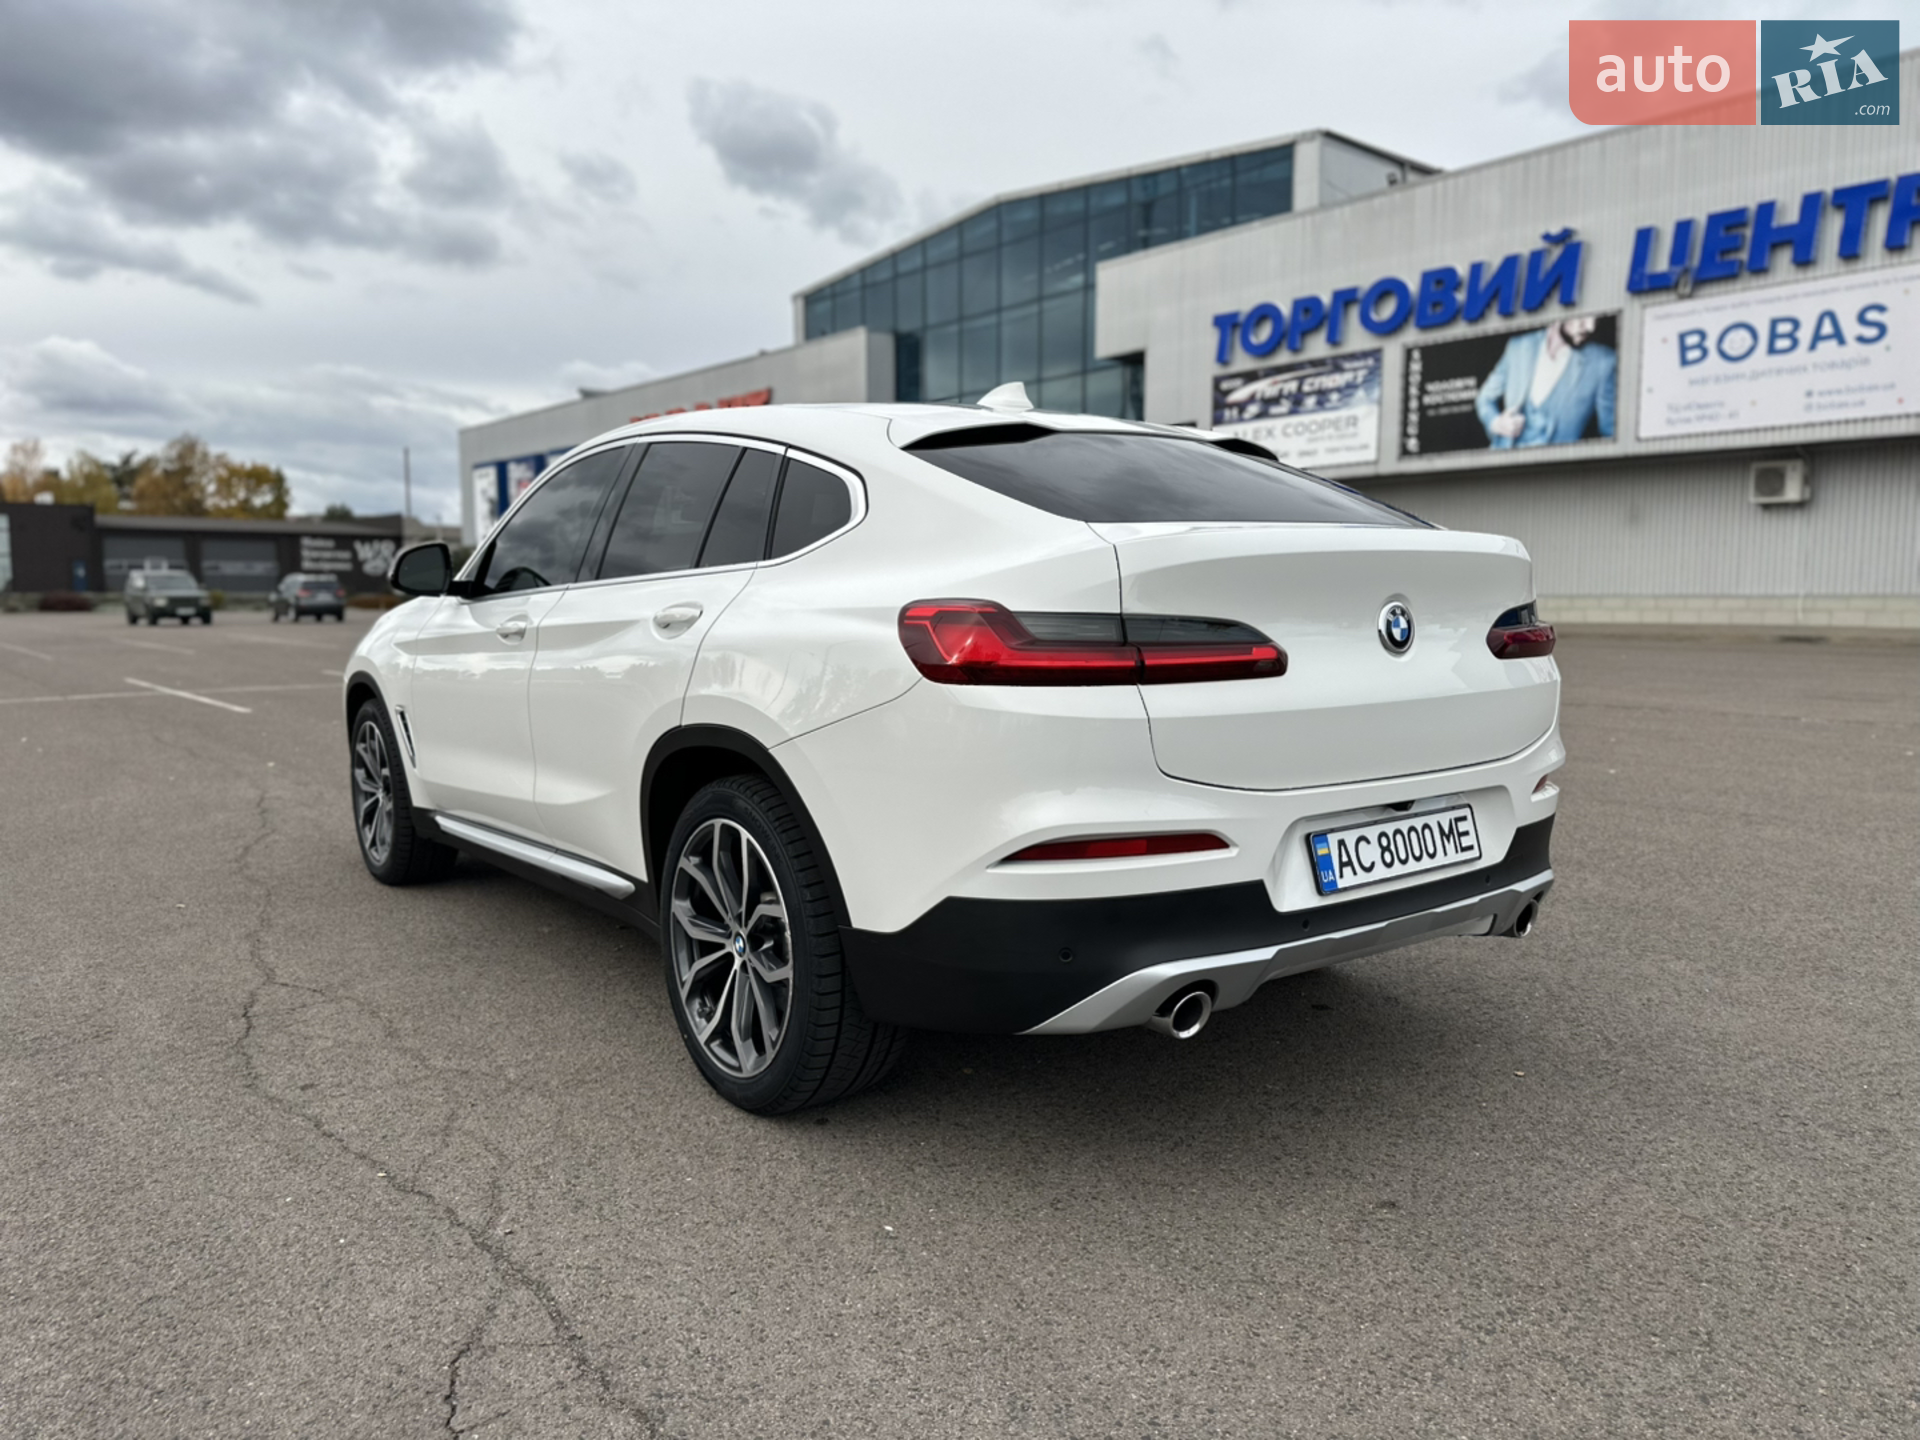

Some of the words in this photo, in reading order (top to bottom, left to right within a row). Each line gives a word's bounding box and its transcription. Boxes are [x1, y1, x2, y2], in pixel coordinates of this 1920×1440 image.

[1213, 229, 1582, 363] ТОРГОВИЙ
[1679, 303, 1889, 368] BOBAS
[1281, 415, 1360, 438] COOPER
[1320, 869, 1336, 883] UA
[1337, 835, 1376, 879] AC
[1377, 822, 1437, 868] 8000
[1437, 815, 1475, 858] ME
